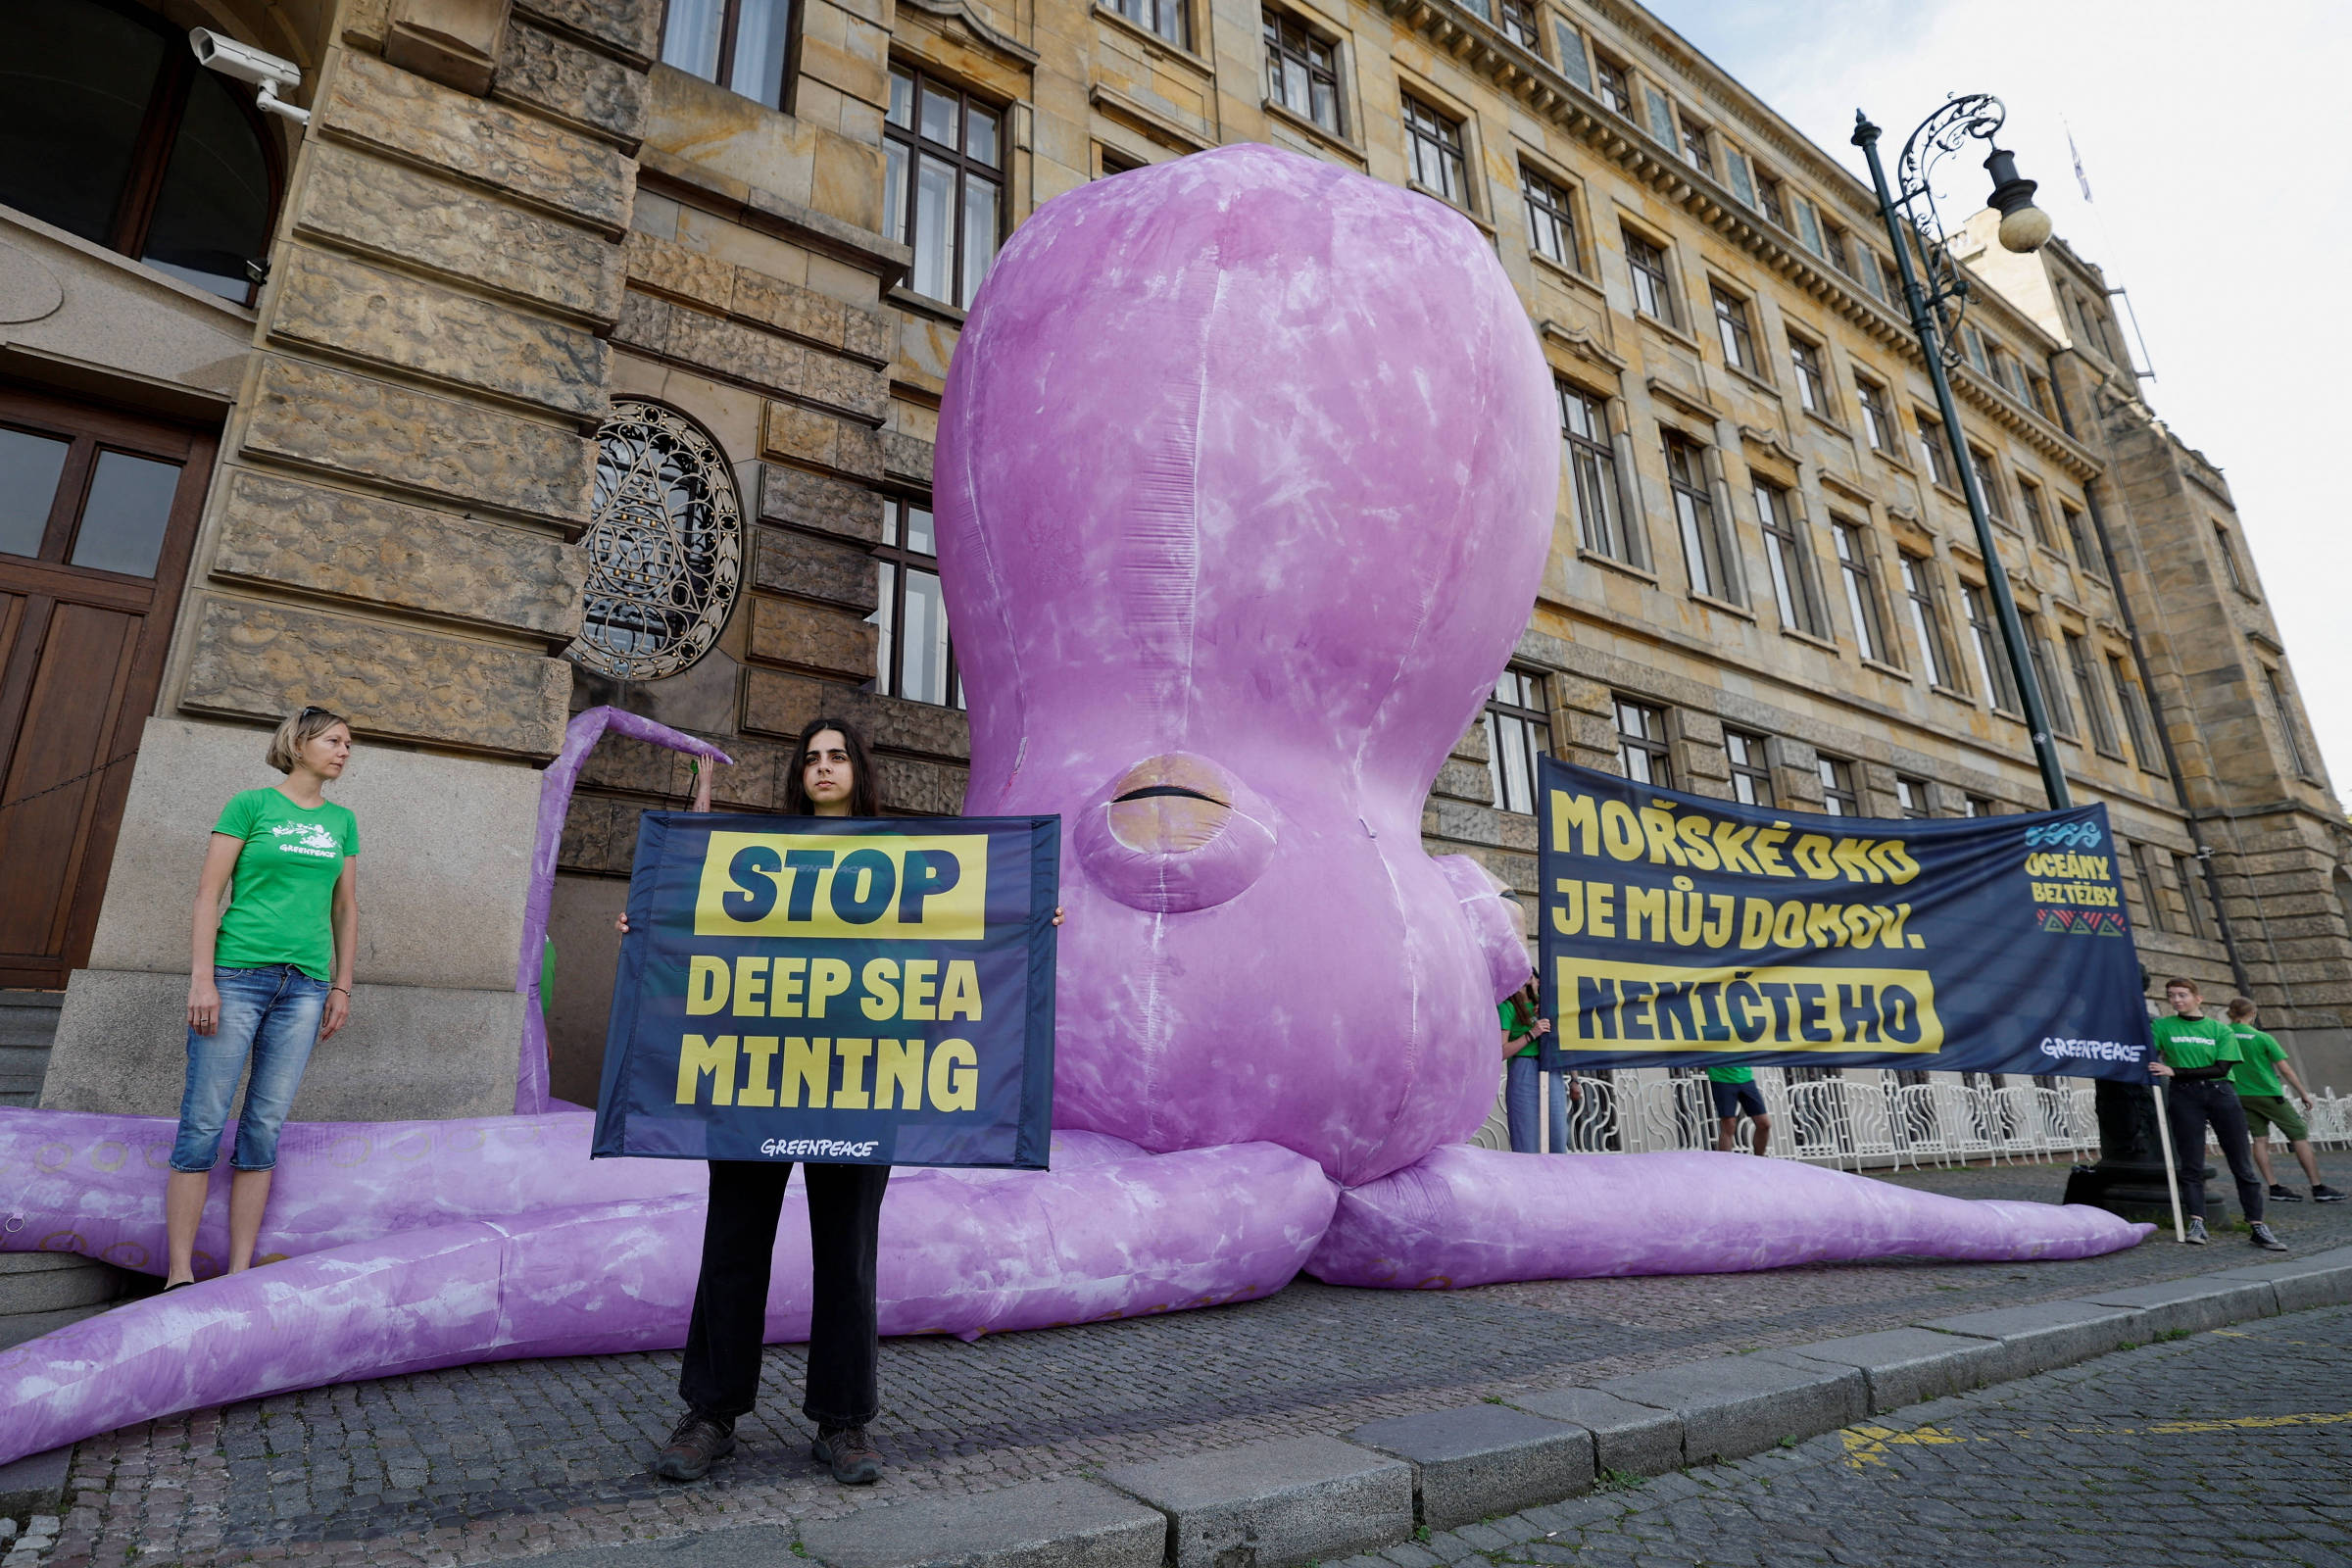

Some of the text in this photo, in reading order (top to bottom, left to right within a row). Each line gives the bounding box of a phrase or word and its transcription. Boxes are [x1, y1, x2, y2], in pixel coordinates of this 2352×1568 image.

[1550, 789, 1921, 886] MOŘSKÉ DNO
[2025, 850, 2111, 880] OCEÁNY
[721, 845, 961, 925] STOP
[1551, 875, 1927, 950] JE MŮJ DOMOV.
[2031, 881, 2119, 906] BEZ TĚŽBY
[686, 956, 983, 1021] DEEP SEA
[675, 1034, 979, 1112] MINING
[2040, 1037, 2146, 1062] GREENPEACE
[760, 1138, 879, 1157] GREENPEACE
